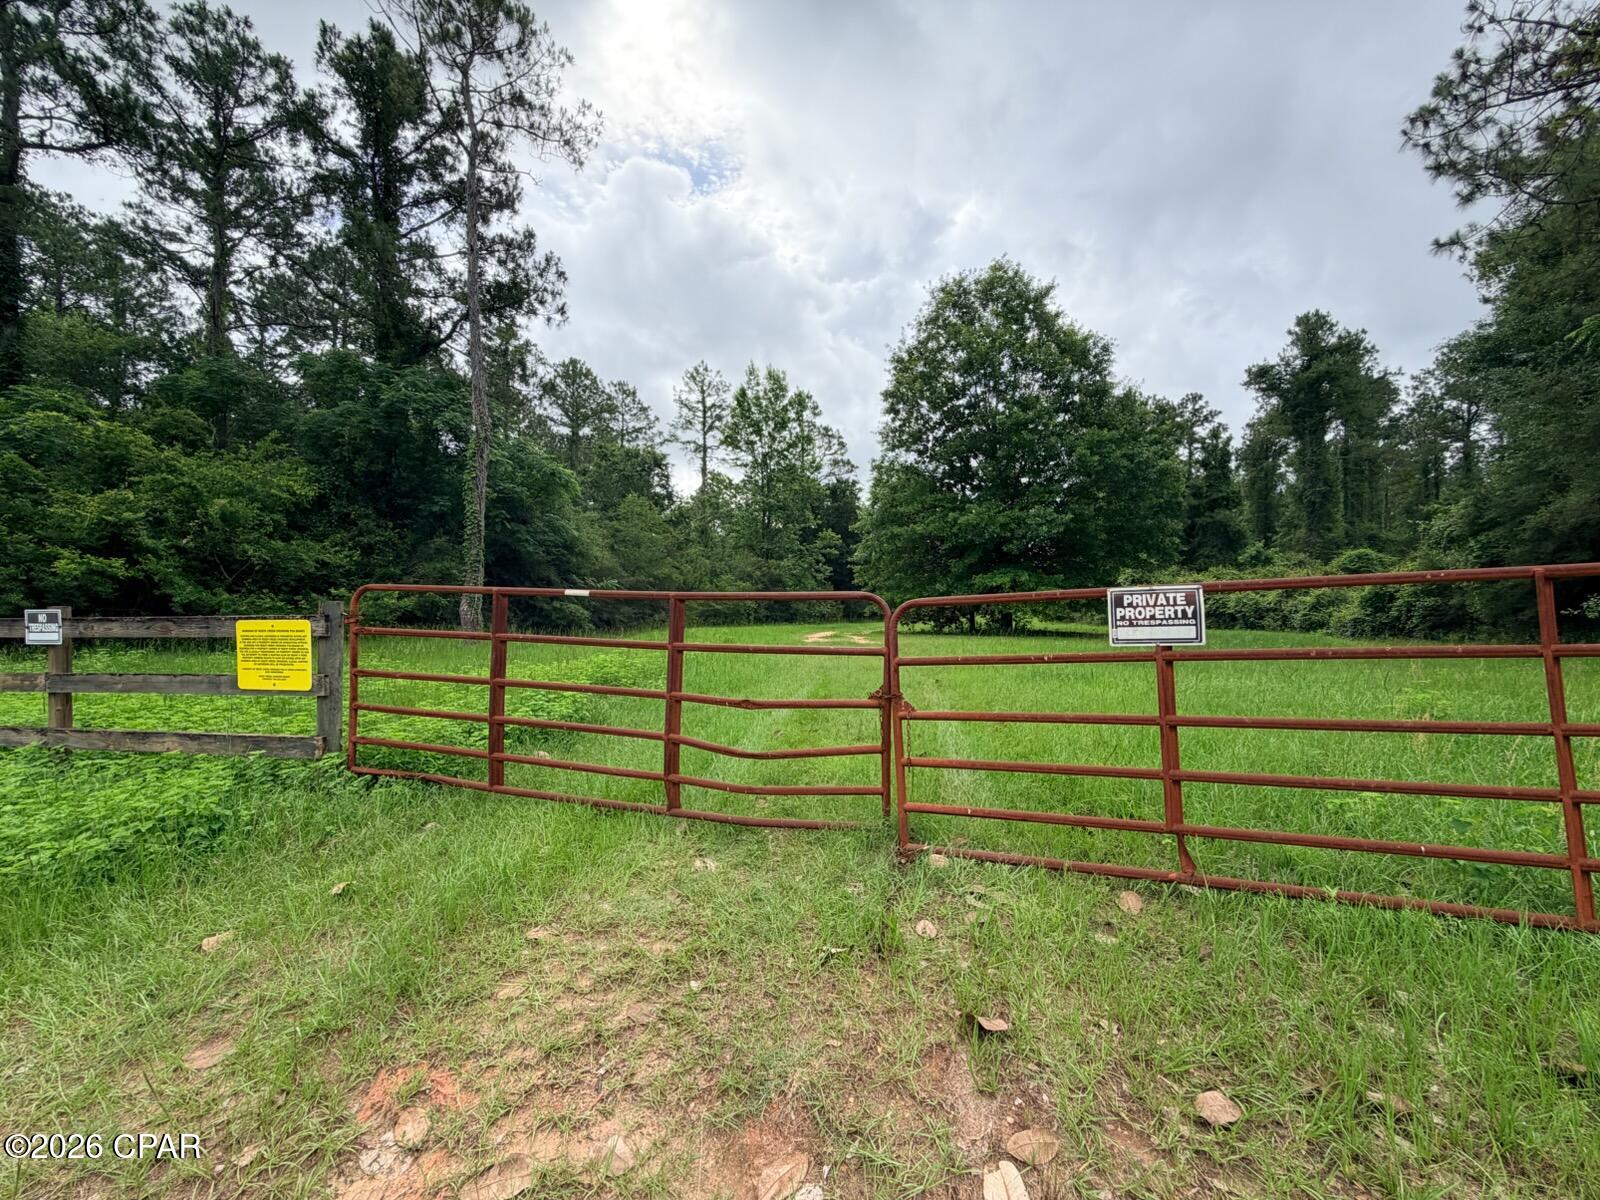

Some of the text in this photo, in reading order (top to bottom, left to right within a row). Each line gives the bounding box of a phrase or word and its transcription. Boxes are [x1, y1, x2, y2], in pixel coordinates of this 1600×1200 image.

[1123, 592, 1187, 607] PRIVATE
[38, 613, 47, 623] NO
[1115, 605, 1195, 620] PROPERTY
